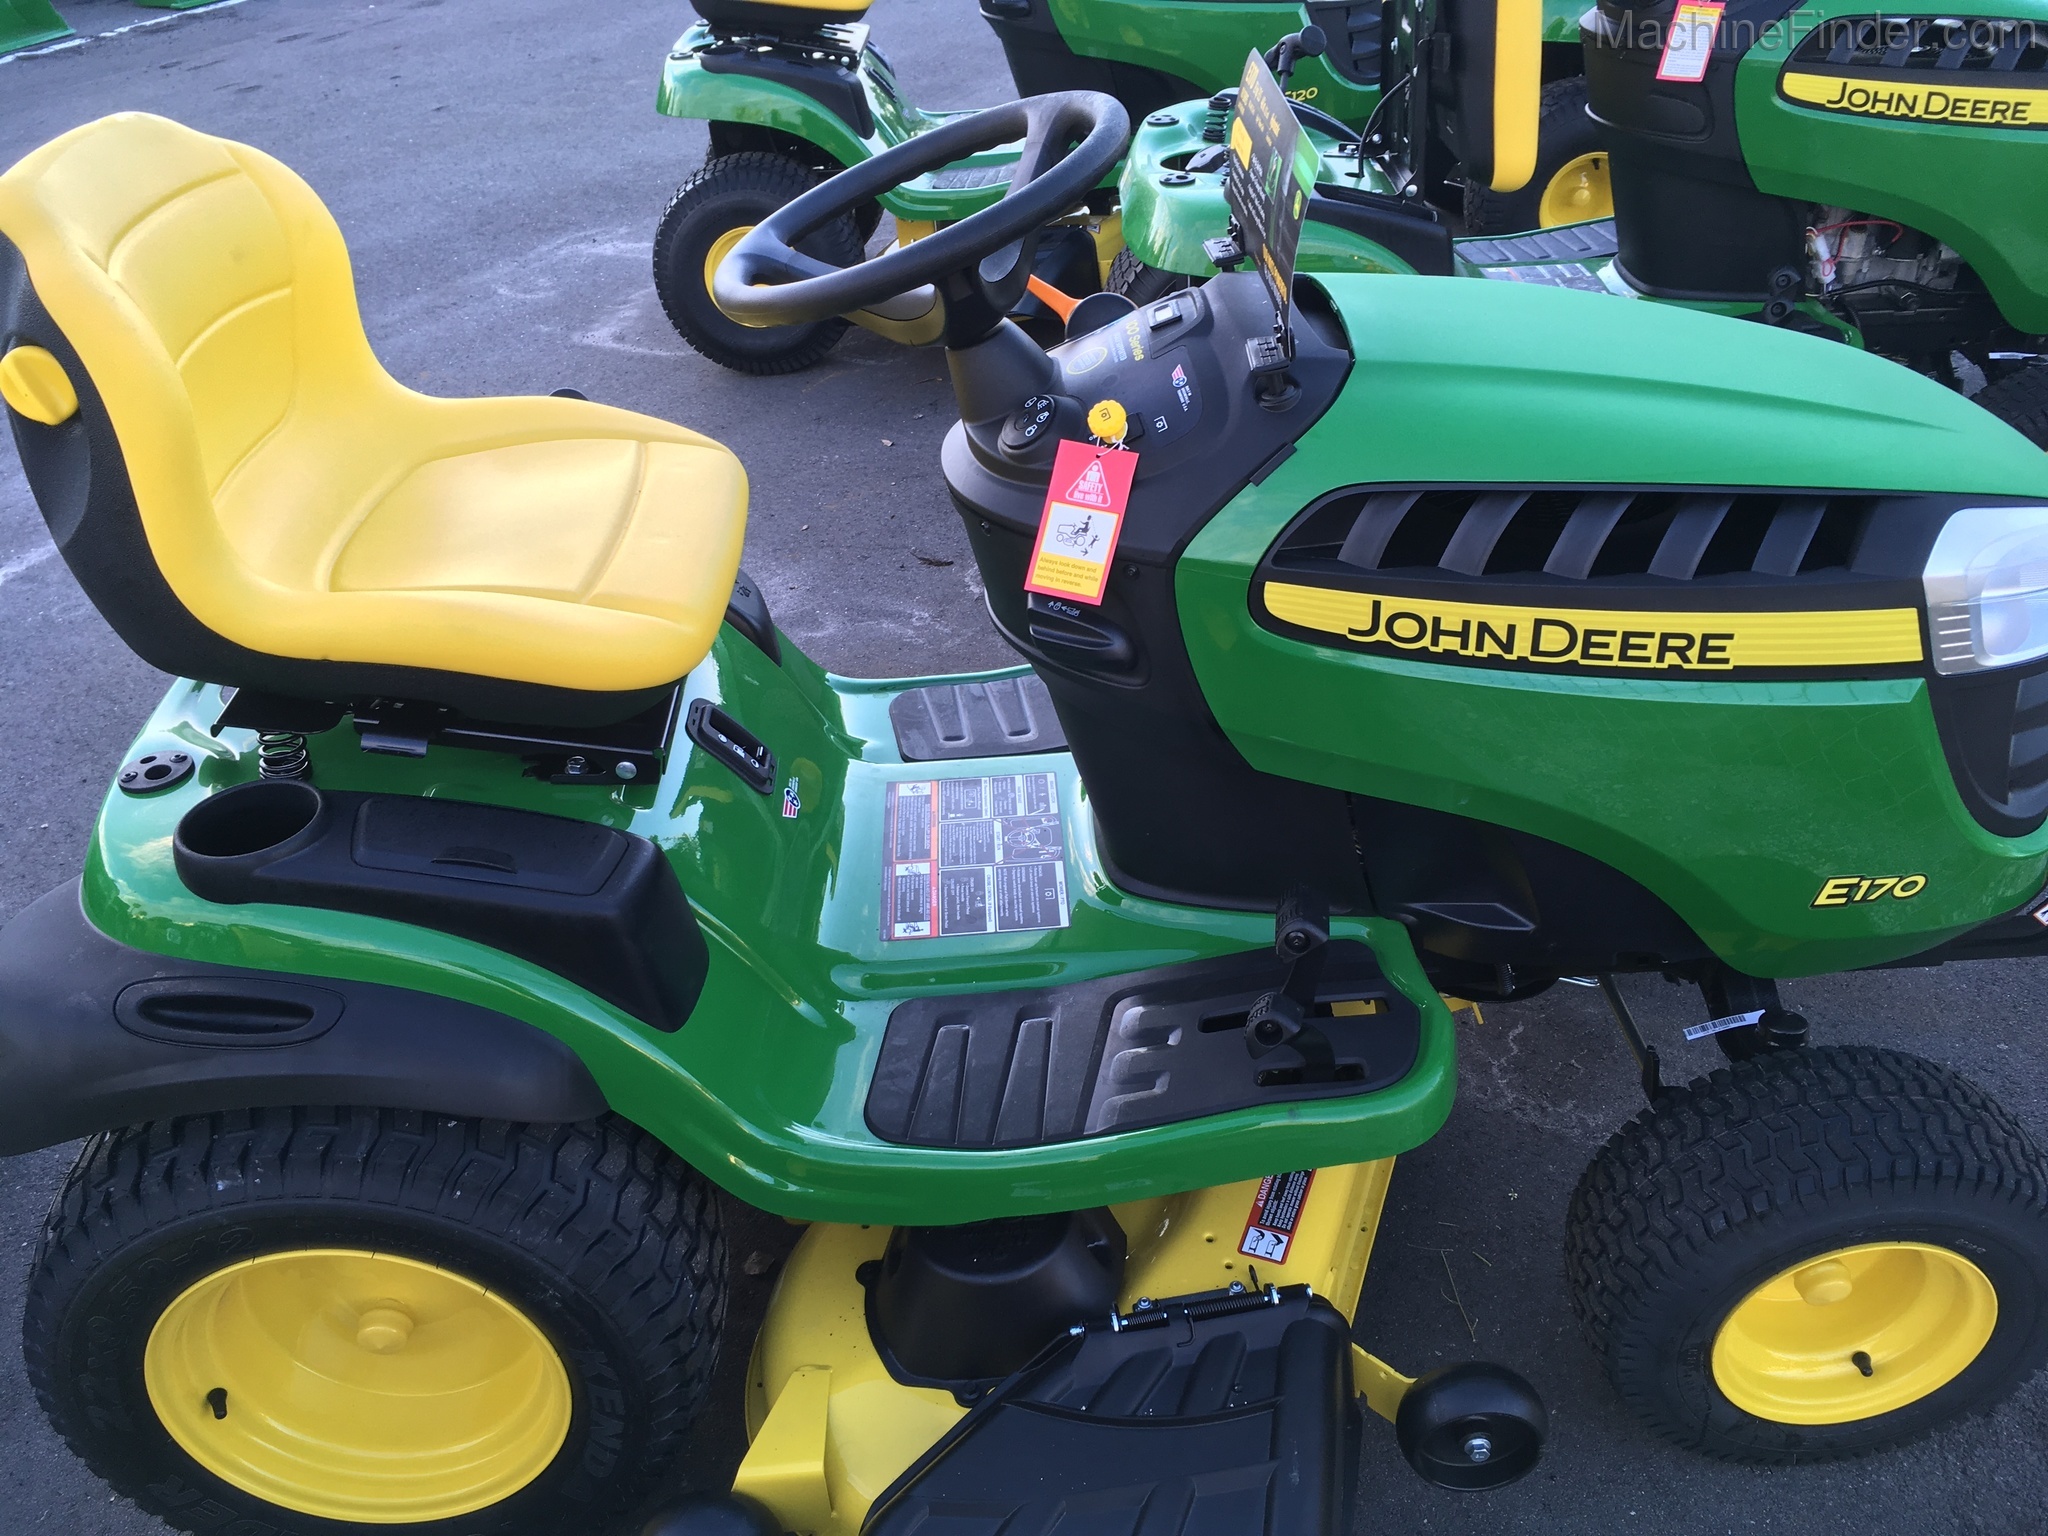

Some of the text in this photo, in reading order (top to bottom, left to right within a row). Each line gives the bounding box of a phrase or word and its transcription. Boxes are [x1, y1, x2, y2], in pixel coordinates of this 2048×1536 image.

[1826, 81, 2032, 121] JOHN DEERE
[1129, 333, 1145, 362] Series
[1078, 479, 1103, 493] SAFETY
[1037, 564, 1055, 572] behind
[1055, 568, 1072, 576] before
[1084, 574, 1098, 582] while
[1039, 556, 1057, 565] Always
[1035, 573, 1054, 582] moving
[1347, 599, 1735, 666] JOHN DEERE
[1811, 874, 1928, 906] E170
[1258, 1174, 1274, 1200] DANGE
